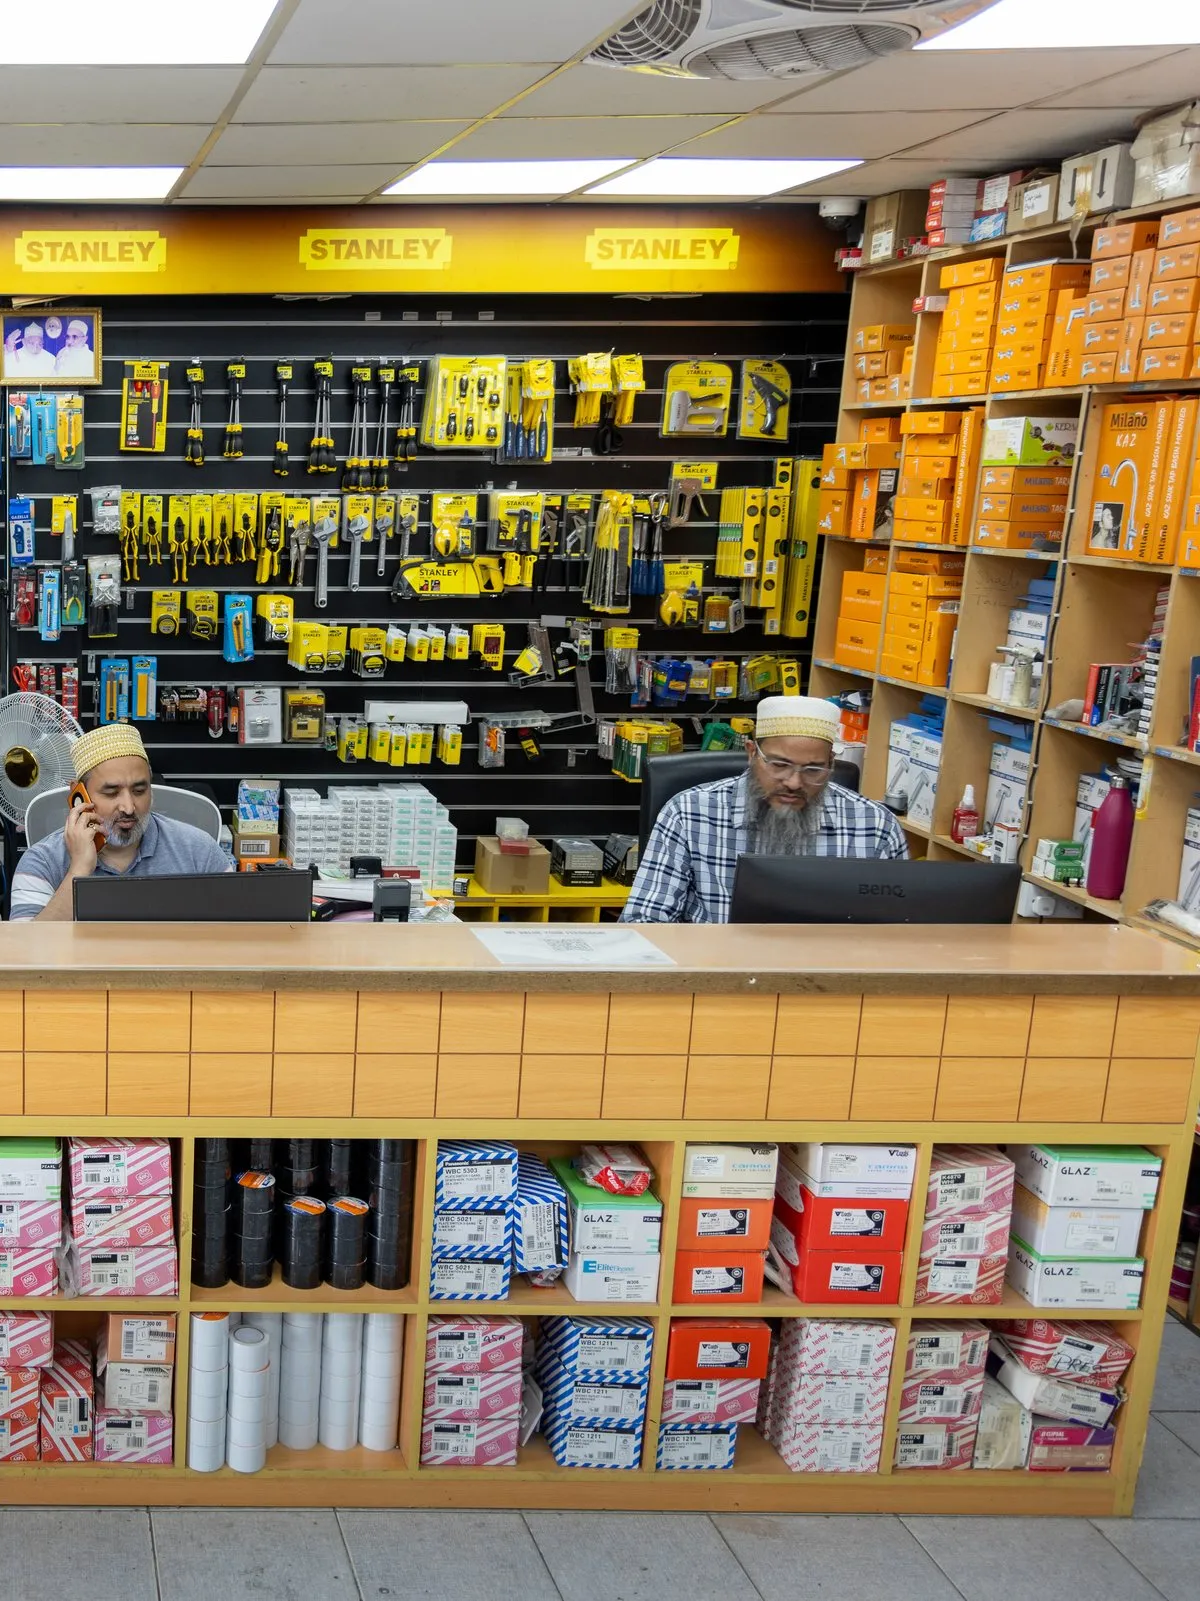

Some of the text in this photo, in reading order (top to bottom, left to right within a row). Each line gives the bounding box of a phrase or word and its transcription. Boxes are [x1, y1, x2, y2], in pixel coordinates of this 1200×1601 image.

[25, 240, 156, 262] STANLEY
[309, 238, 441, 260] STANLEY
[596, 238, 728, 260] STANLEY
[1110, 412, 1148, 429] Milano
[1155, 408, 1166, 446] MOUNTED
[1174, 408, 1186, 446] MOUNTED
[1152, 447, 1160, 468] BASIN
[1170, 446, 1180, 470] BASIN
[1138, 524, 1150, 558] Milano
[1157, 524, 1168, 560] Milano
[419, 568, 458, 577] STANLEY
[858, 883, 906, 898] BenQ
[812, 1334, 828, 1346] tenby
[877, 1336, 893, 1348] tenby
[810, 1347, 826, 1360] tenby
[875, 1350, 891, 1363] tenby
[808, 1383, 824, 1396] tenby
[806, 1398, 822, 1411] tenby
